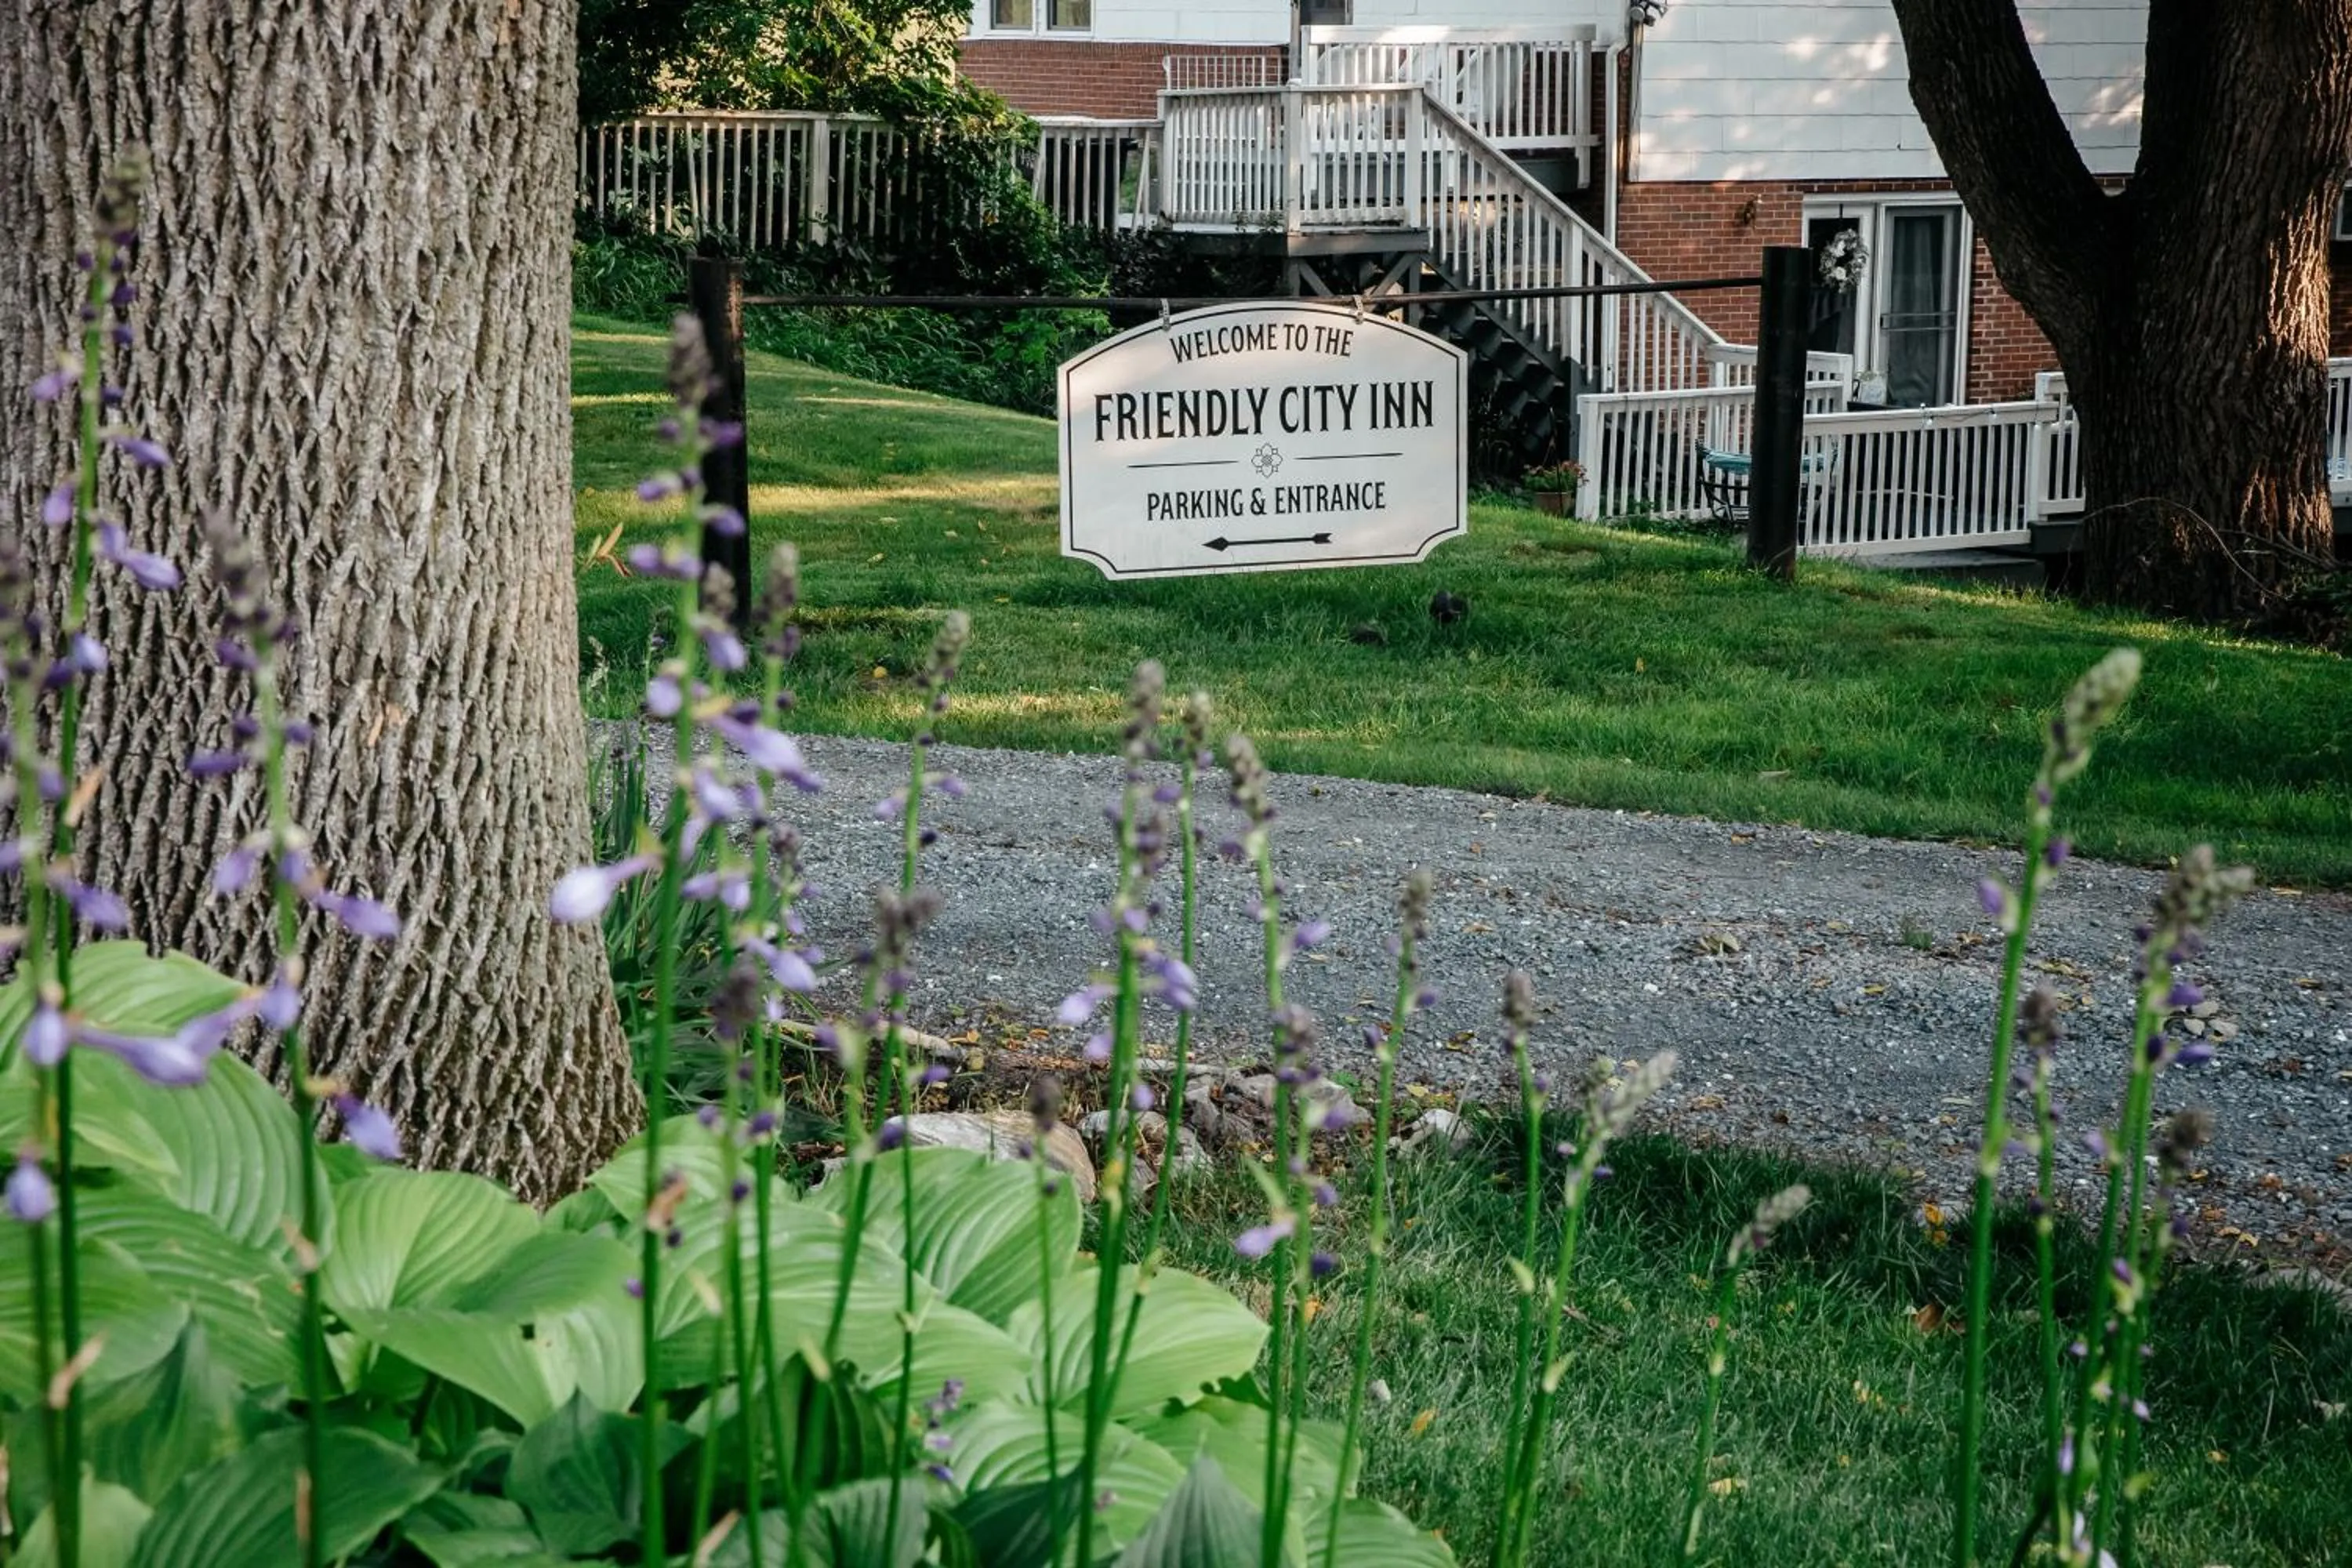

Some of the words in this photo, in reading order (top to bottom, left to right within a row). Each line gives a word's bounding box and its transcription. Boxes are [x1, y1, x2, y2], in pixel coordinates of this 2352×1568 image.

[1170, 323, 1278, 364] WELCOME
[1283, 323, 1308, 352] TO
[1315, 325, 1354, 358] THE
[1094, 387, 1270, 442] FRIENDLY
[1279, 383, 1359, 434] CITY
[1369, 380, 1434, 430] INN
[1147, 488, 1243, 521] PARKING
[1250, 487, 1268, 516] &
[1275, 481, 1386, 515] ENTRANCE
